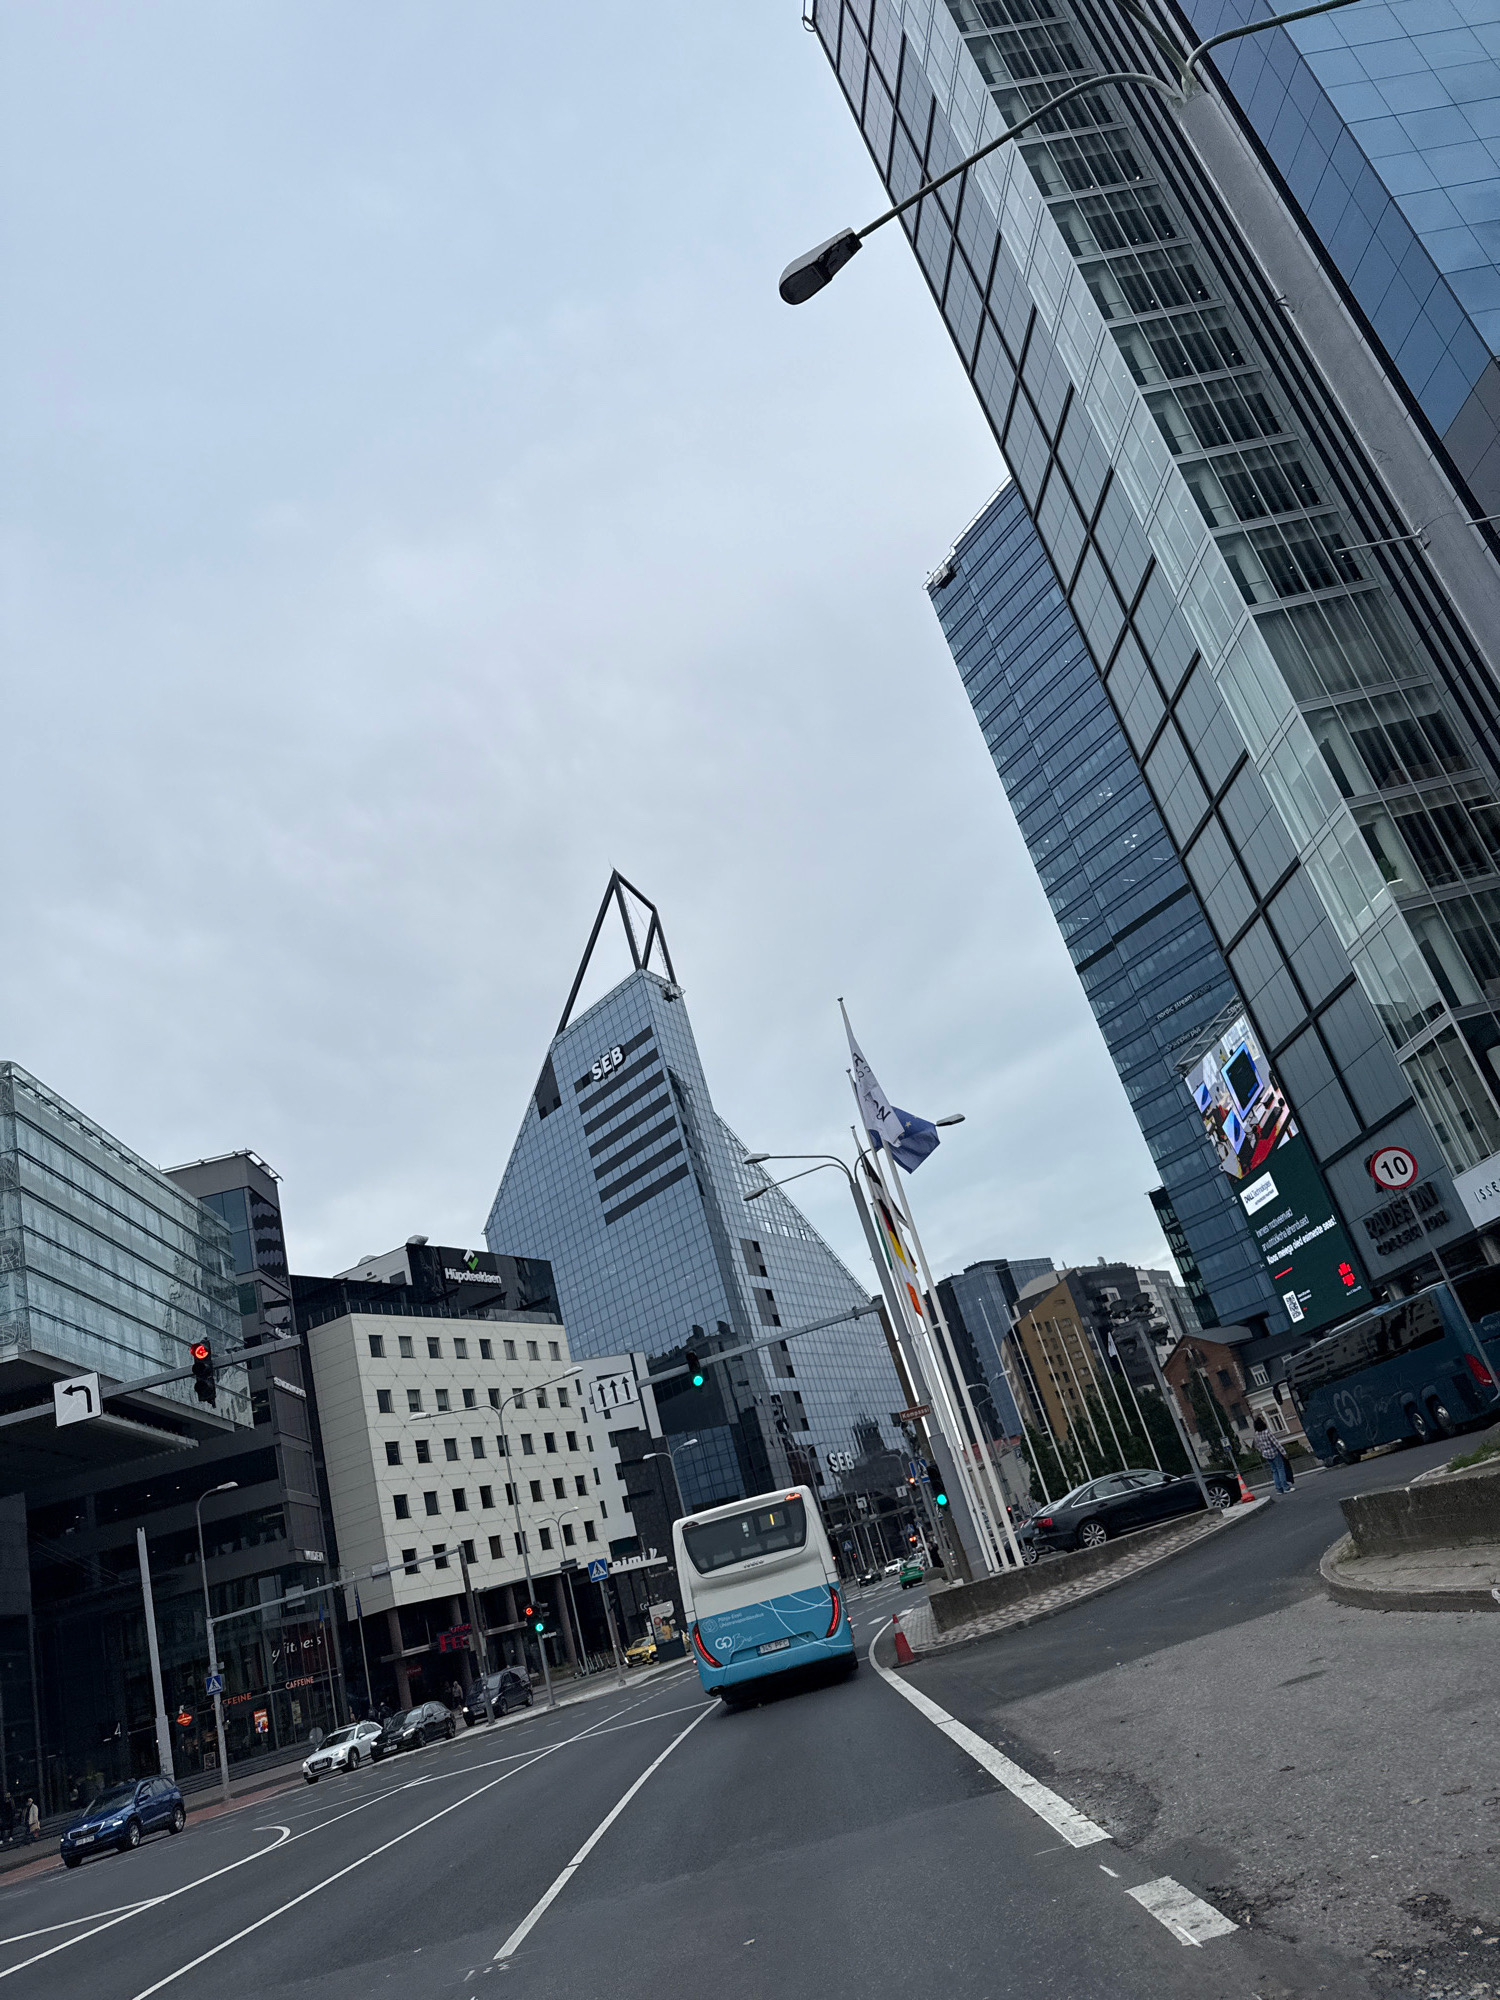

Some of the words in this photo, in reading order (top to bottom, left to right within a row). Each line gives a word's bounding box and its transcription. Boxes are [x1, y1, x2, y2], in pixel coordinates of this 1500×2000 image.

[591, 1046, 624, 1081] SEB
[1381, 1156, 1408, 1179] 10
[1474, 1178, 1500, 1203] ISSE
[444, 1267, 502, 1284] Hüpoteeklaen
[901, 1406, 930, 1420] Kompassi
[828, 1451, 855, 1473] SEB
[285, 1676, 314, 1690] CAFFEINE
